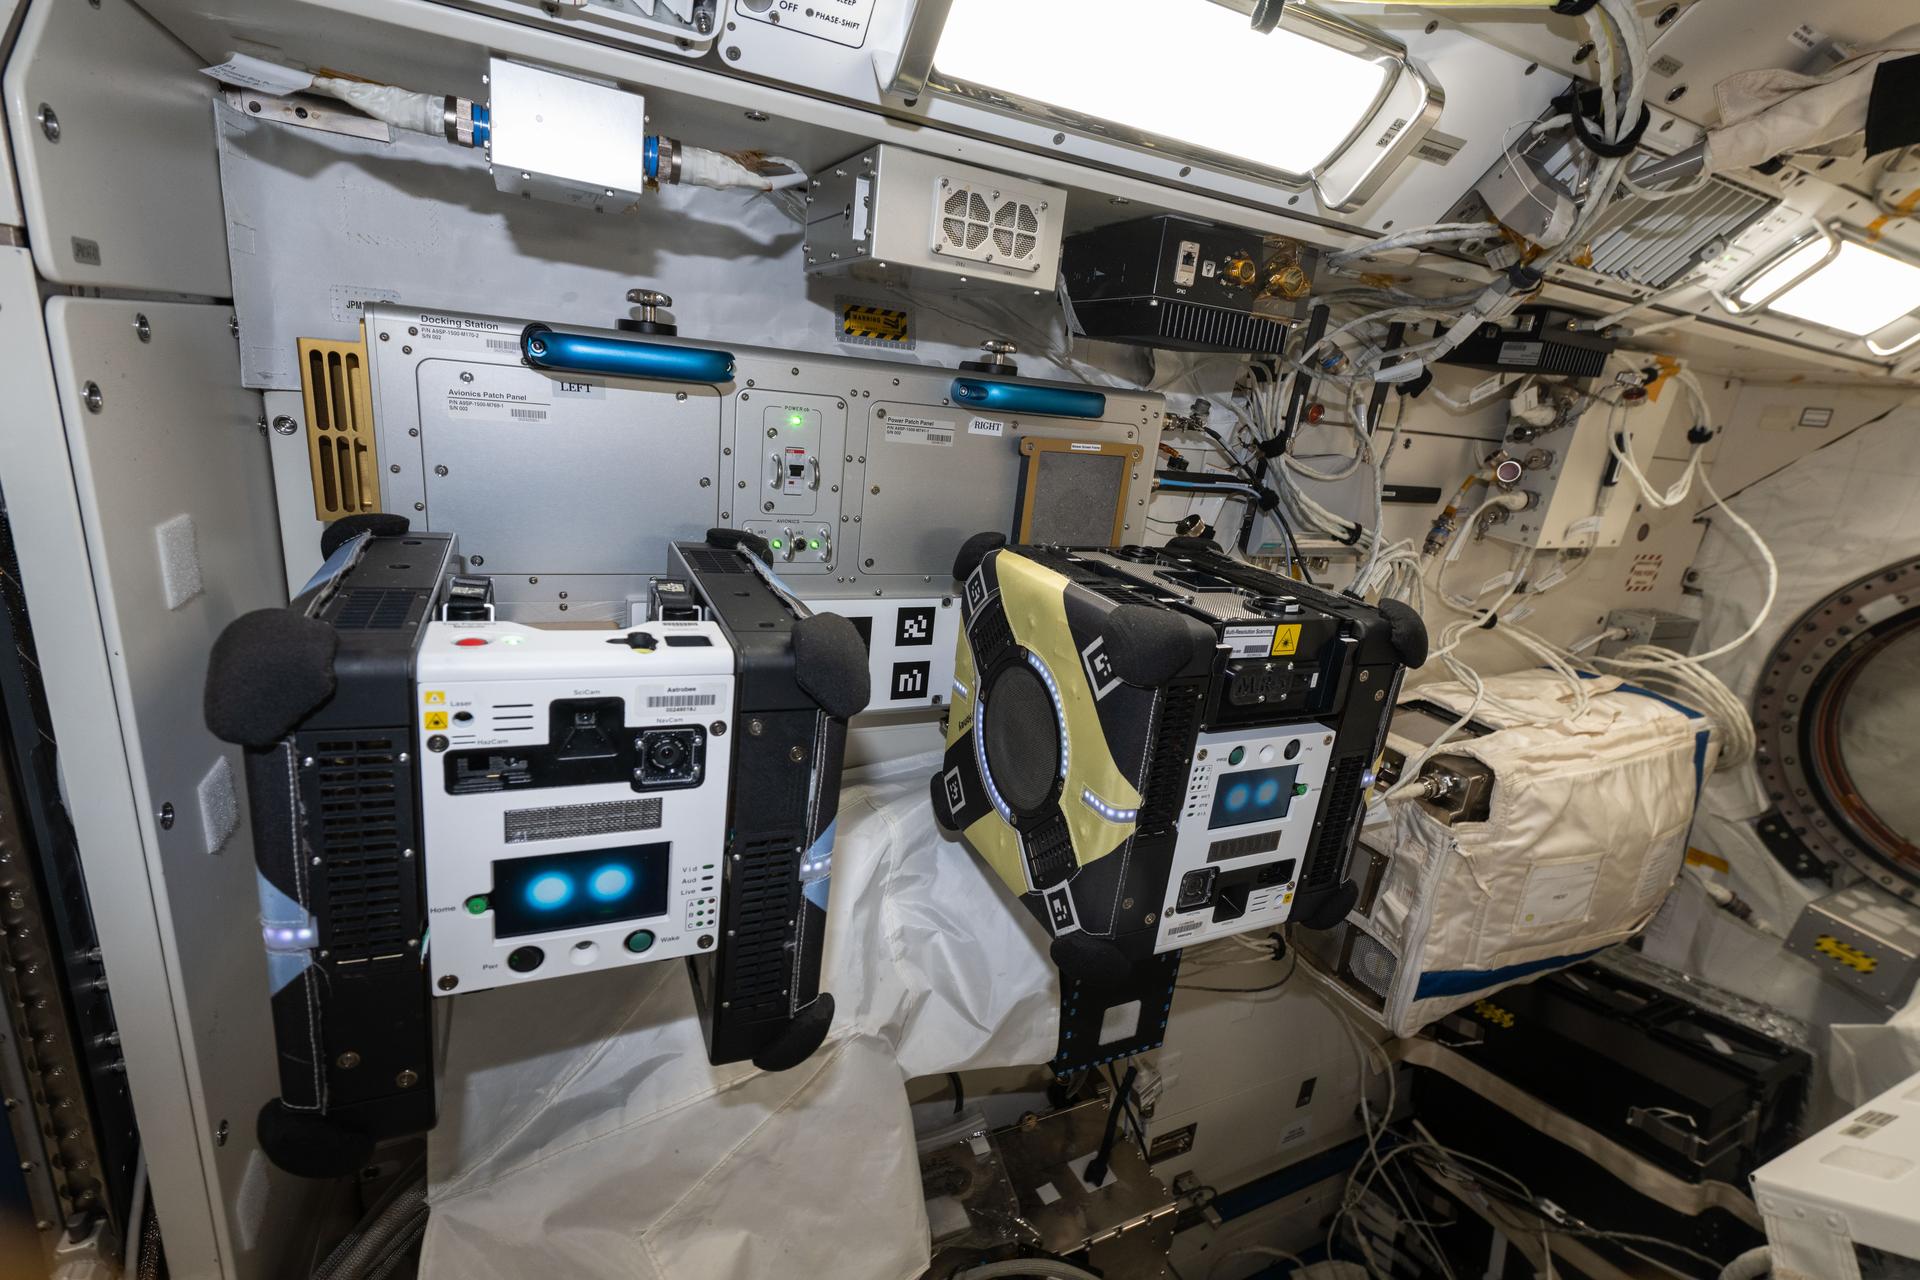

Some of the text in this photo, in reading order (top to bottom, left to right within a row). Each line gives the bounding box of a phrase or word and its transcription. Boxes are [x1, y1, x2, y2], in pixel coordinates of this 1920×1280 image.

[779, 1, 798, 12] OFF
[815, 11, 860, 30] PHASE-SHIFT
[346, 300, 365, 310] JPM
[421, 314, 499, 331] Docking Station
[560, 382, 592, 393] LEFT
[448, 388, 527, 401] Avionics Patch Panel
[974, 420, 1001, 432] RIGHT
[656, 716, 683, 724] NavCam
[477, 737, 509, 746] HazCam
[680, 889, 696, 897] Live
[430, 905, 456, 914] Home
[660, 935, 680, 943] Wake
